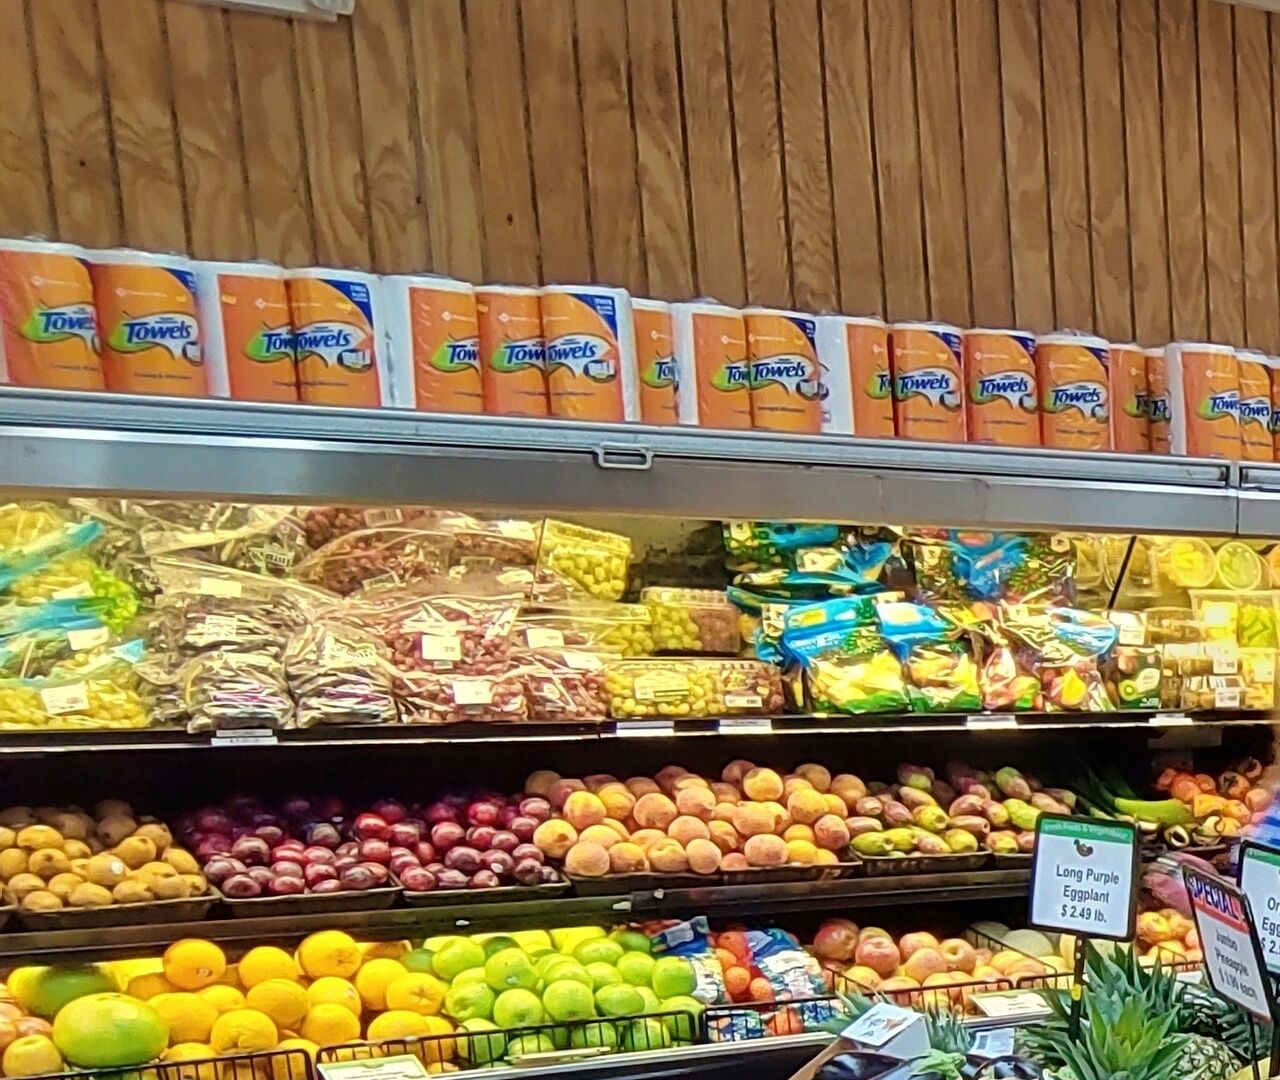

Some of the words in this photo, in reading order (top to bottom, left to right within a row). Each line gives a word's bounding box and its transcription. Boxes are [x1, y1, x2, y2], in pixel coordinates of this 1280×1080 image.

[122, 321, 192, 344] Towels
[262, 332, 294, 354] Tow
[446, 344, 479, 364] Tow
[503, 344, 546, 365] Tow
[725, 362, 750, 383] Tow
[751, 361, 807, 384] Towels
[897, 373, 950, 395] Towels
[978, 376, 1030, 398] Towels
[1051, 386, 1100, 407] Towels
[1056, 864, 1083, 883] Long
[1086, 868, 1120, 886] Purple
[1063, 885, 1110, 903] Eggplant
[1061, 903, 1068, 918] $
[1070, 905, 1092, 920] 2.49
[1094, 910, 1107, 924] lb.
